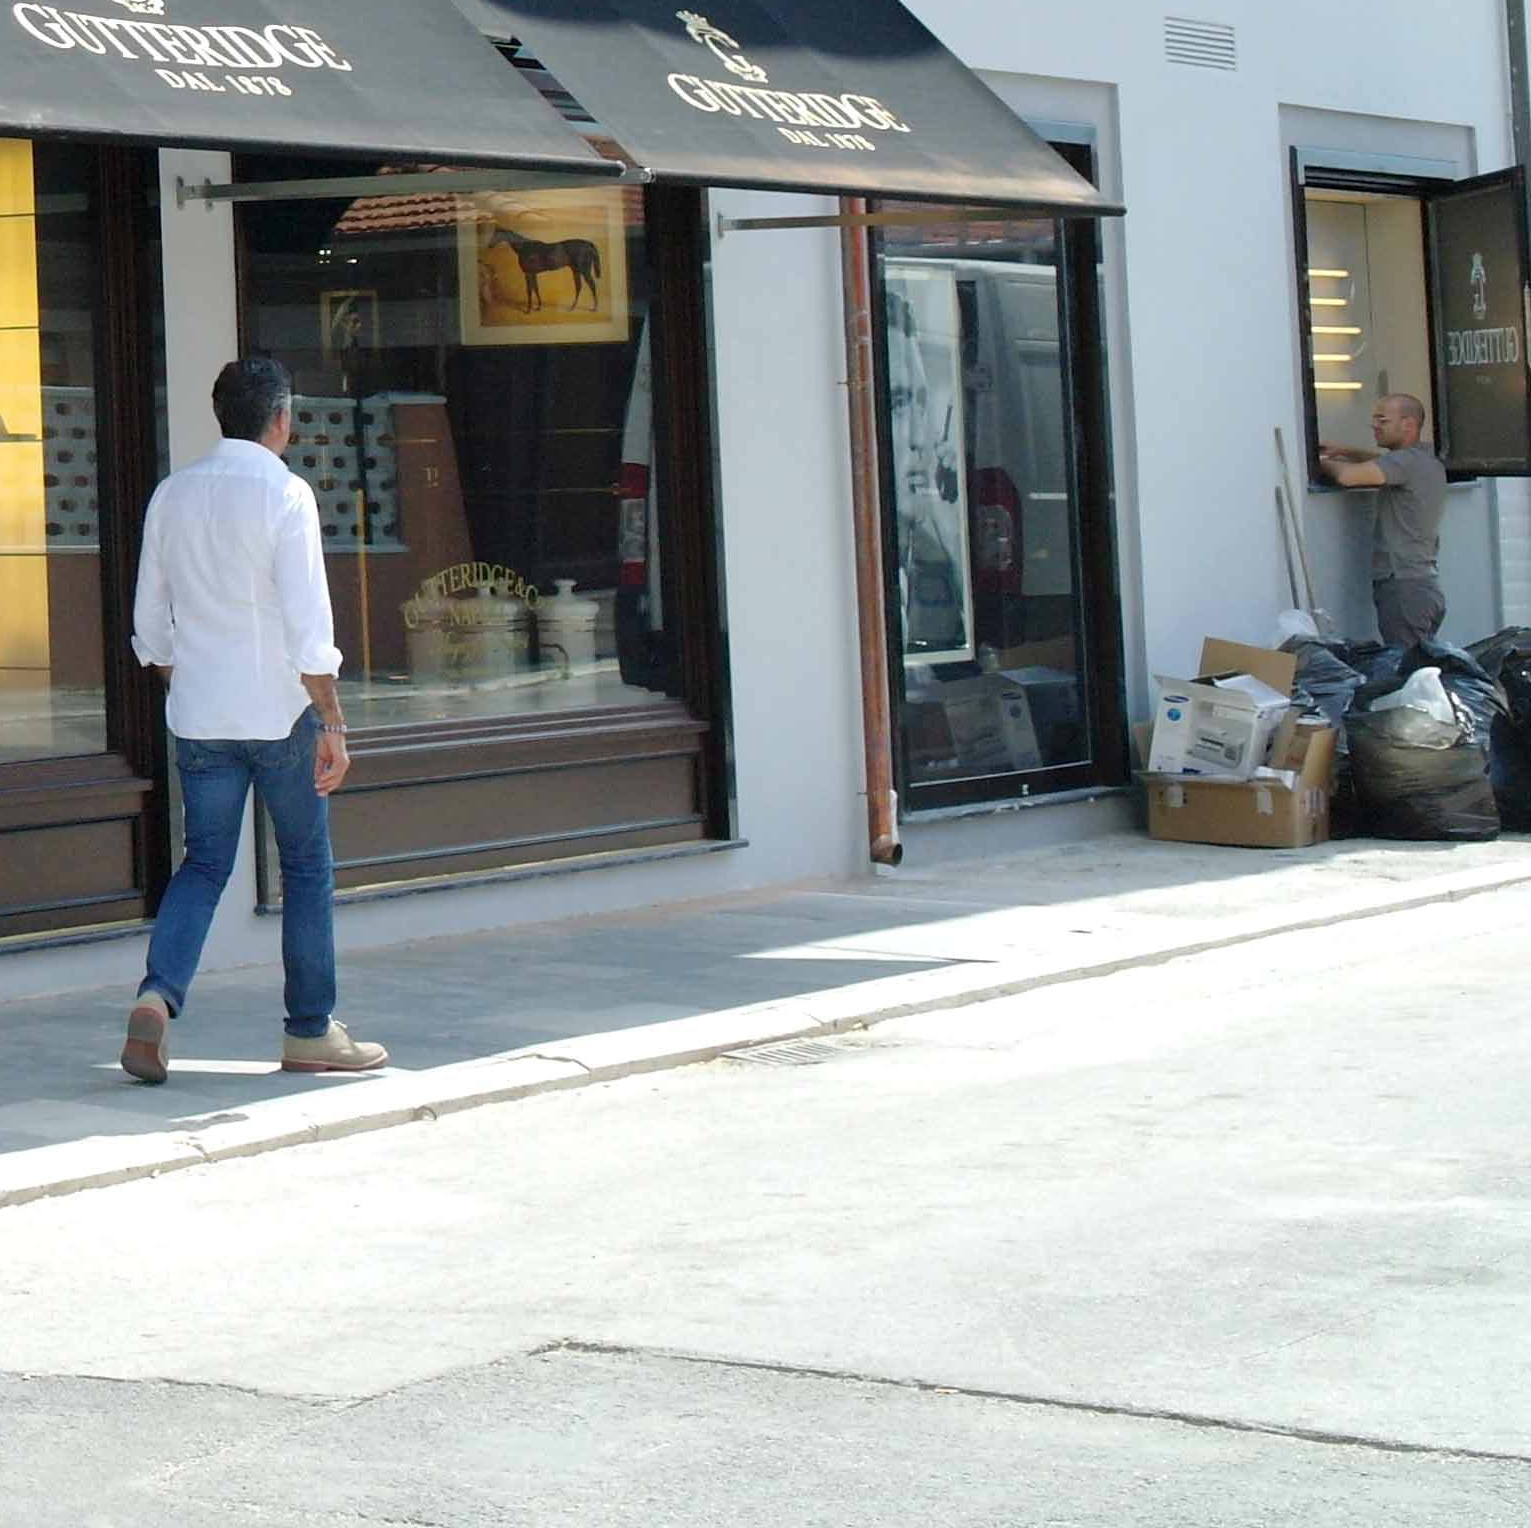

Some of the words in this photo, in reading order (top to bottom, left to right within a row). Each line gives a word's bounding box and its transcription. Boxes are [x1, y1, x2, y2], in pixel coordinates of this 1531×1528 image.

[12, 2, 352, 72] GUTTERIDGE
[155, 68, 225, 92] DAL
[225, 74, 292, 97] 1878
[667, 72, 911, 133] GUTTERIDGE
[777, 127, 830, 148] DAL
[824, 132, 876, 151] 1878
